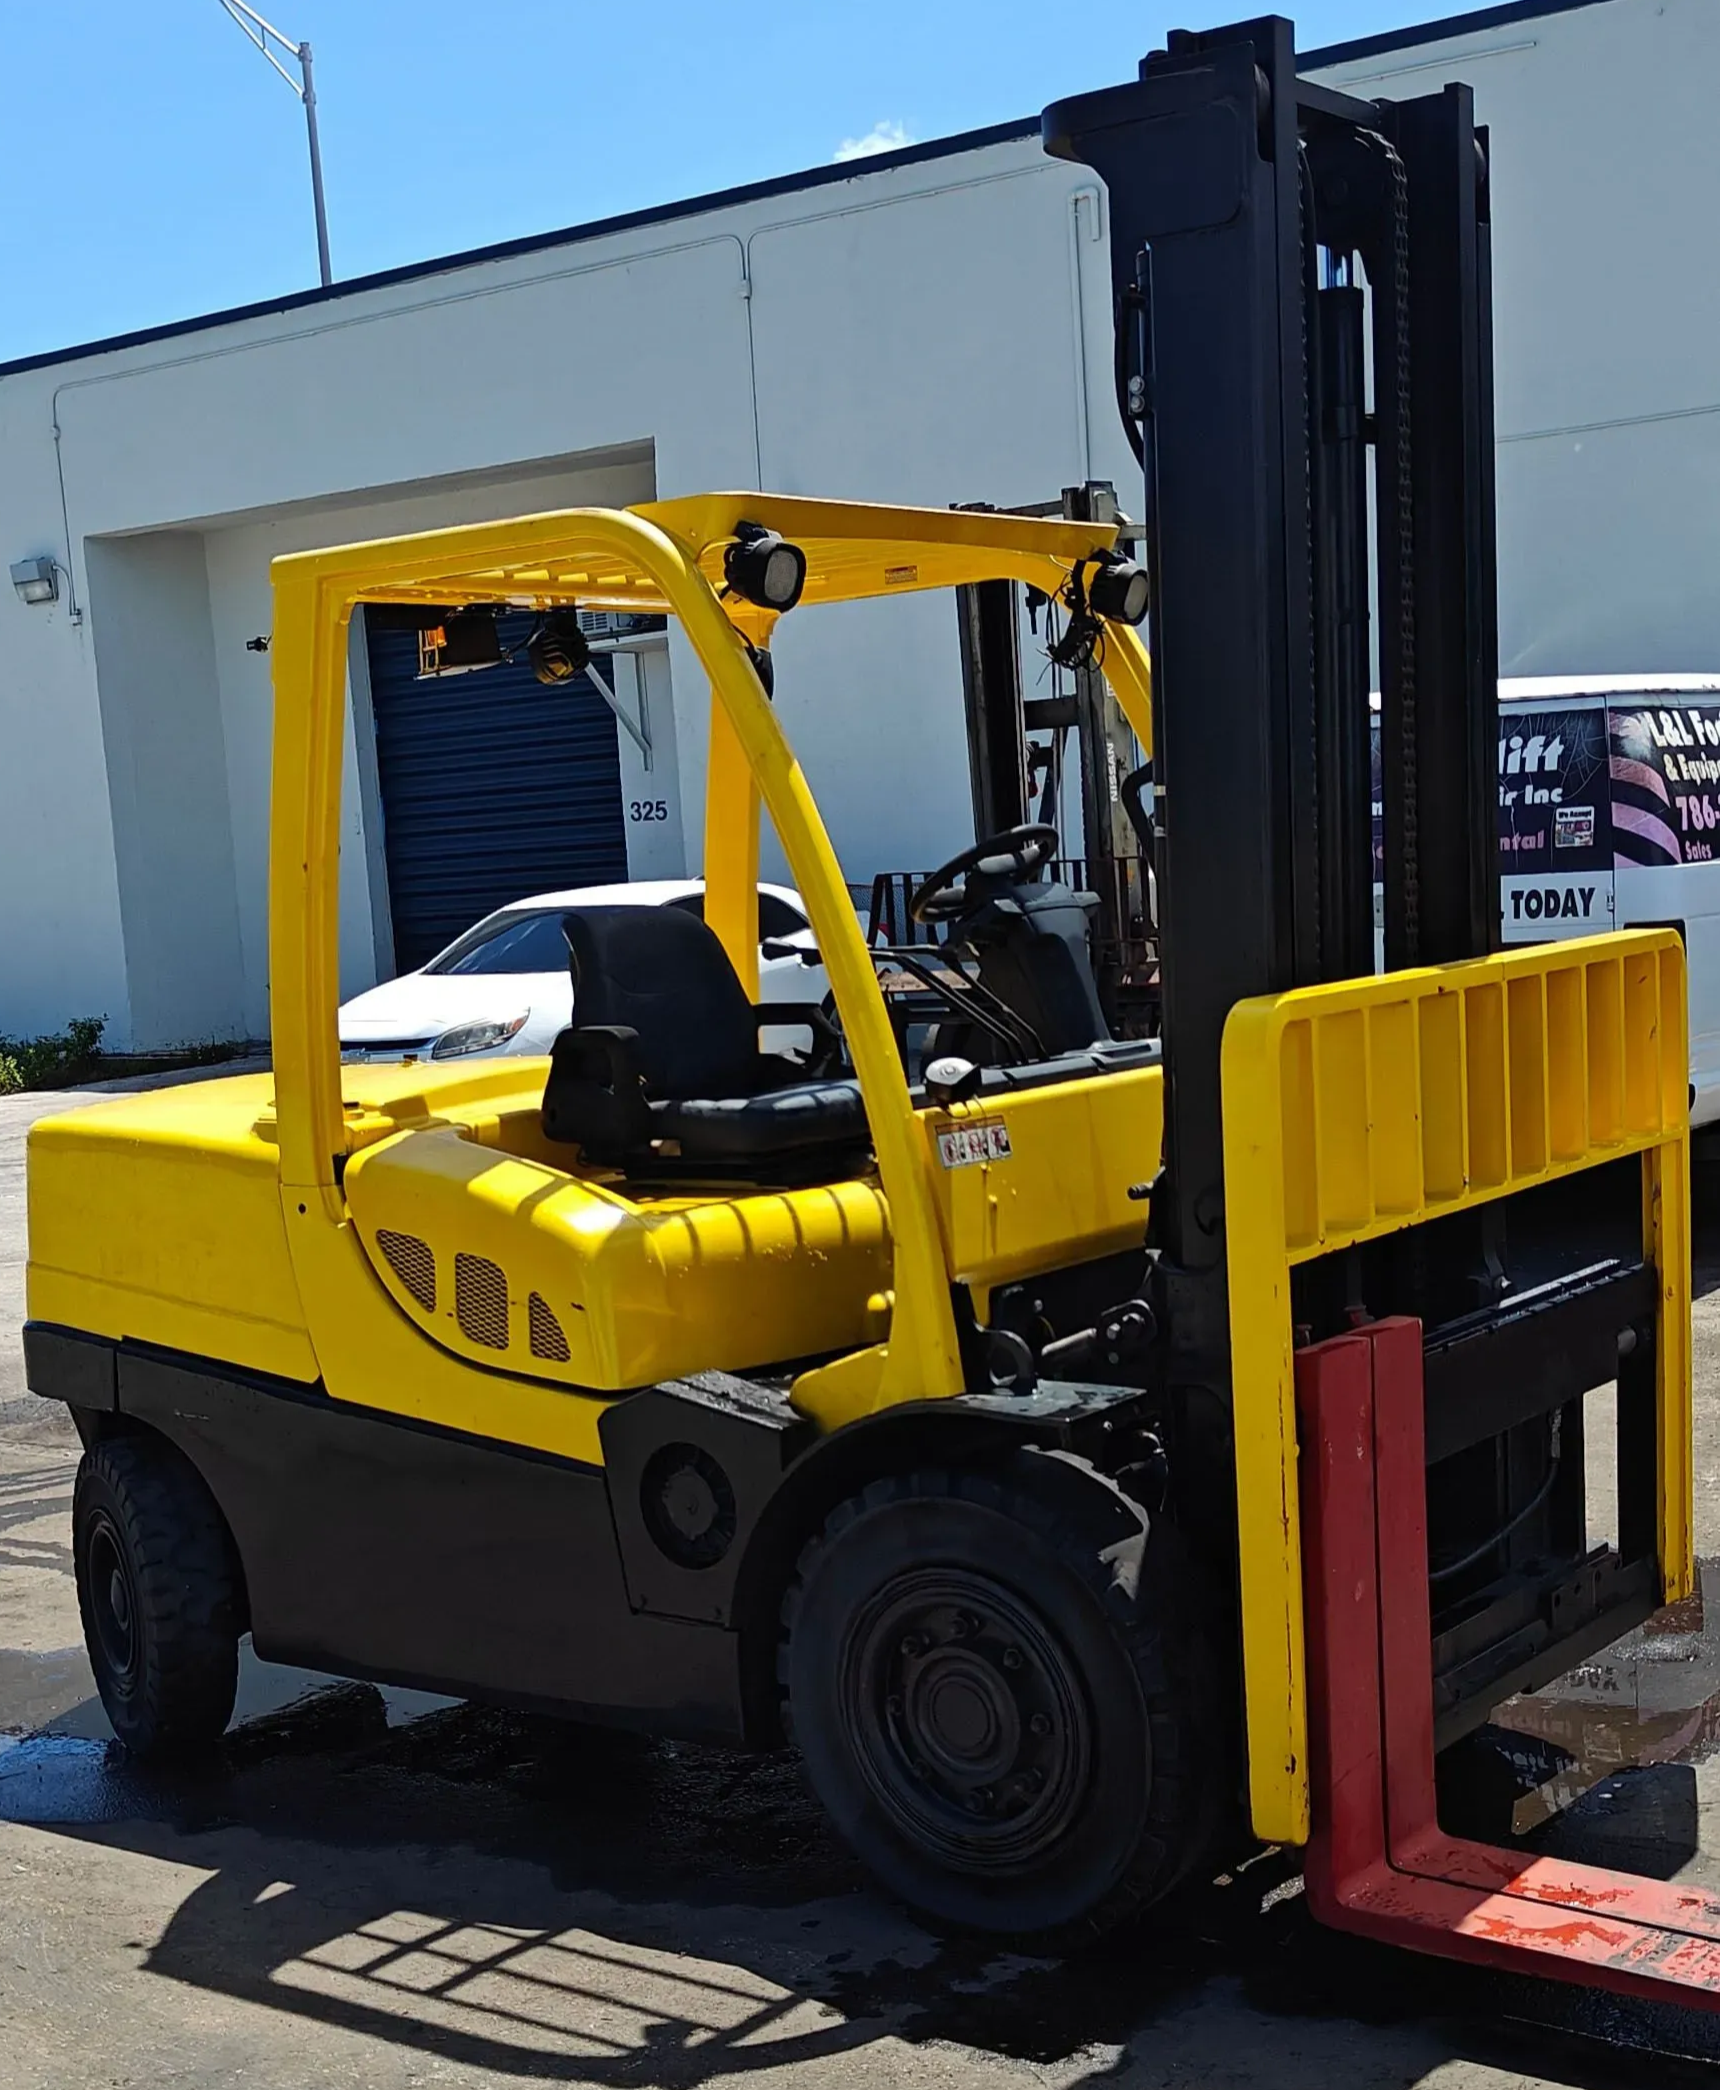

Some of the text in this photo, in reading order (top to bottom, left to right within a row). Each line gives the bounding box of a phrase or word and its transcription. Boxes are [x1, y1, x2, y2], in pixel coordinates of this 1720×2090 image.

[1643, 710, 1694, 747] L&L
[1499, 735, 1565, 774] lift
[1663, 752, 1720, 787] & Equip
[1106, 742, 1118, 802] NISSAN
[631, 801, 668, 821] 325
[1525, 785, 1563, 805] Inc
[1675, 794, 1720, 831] 786-
[1500, 830, 1544, 851] ntal
[1685, 840, 1712, 860] Sales
[1511, 887, 1596, 919] TODAY
